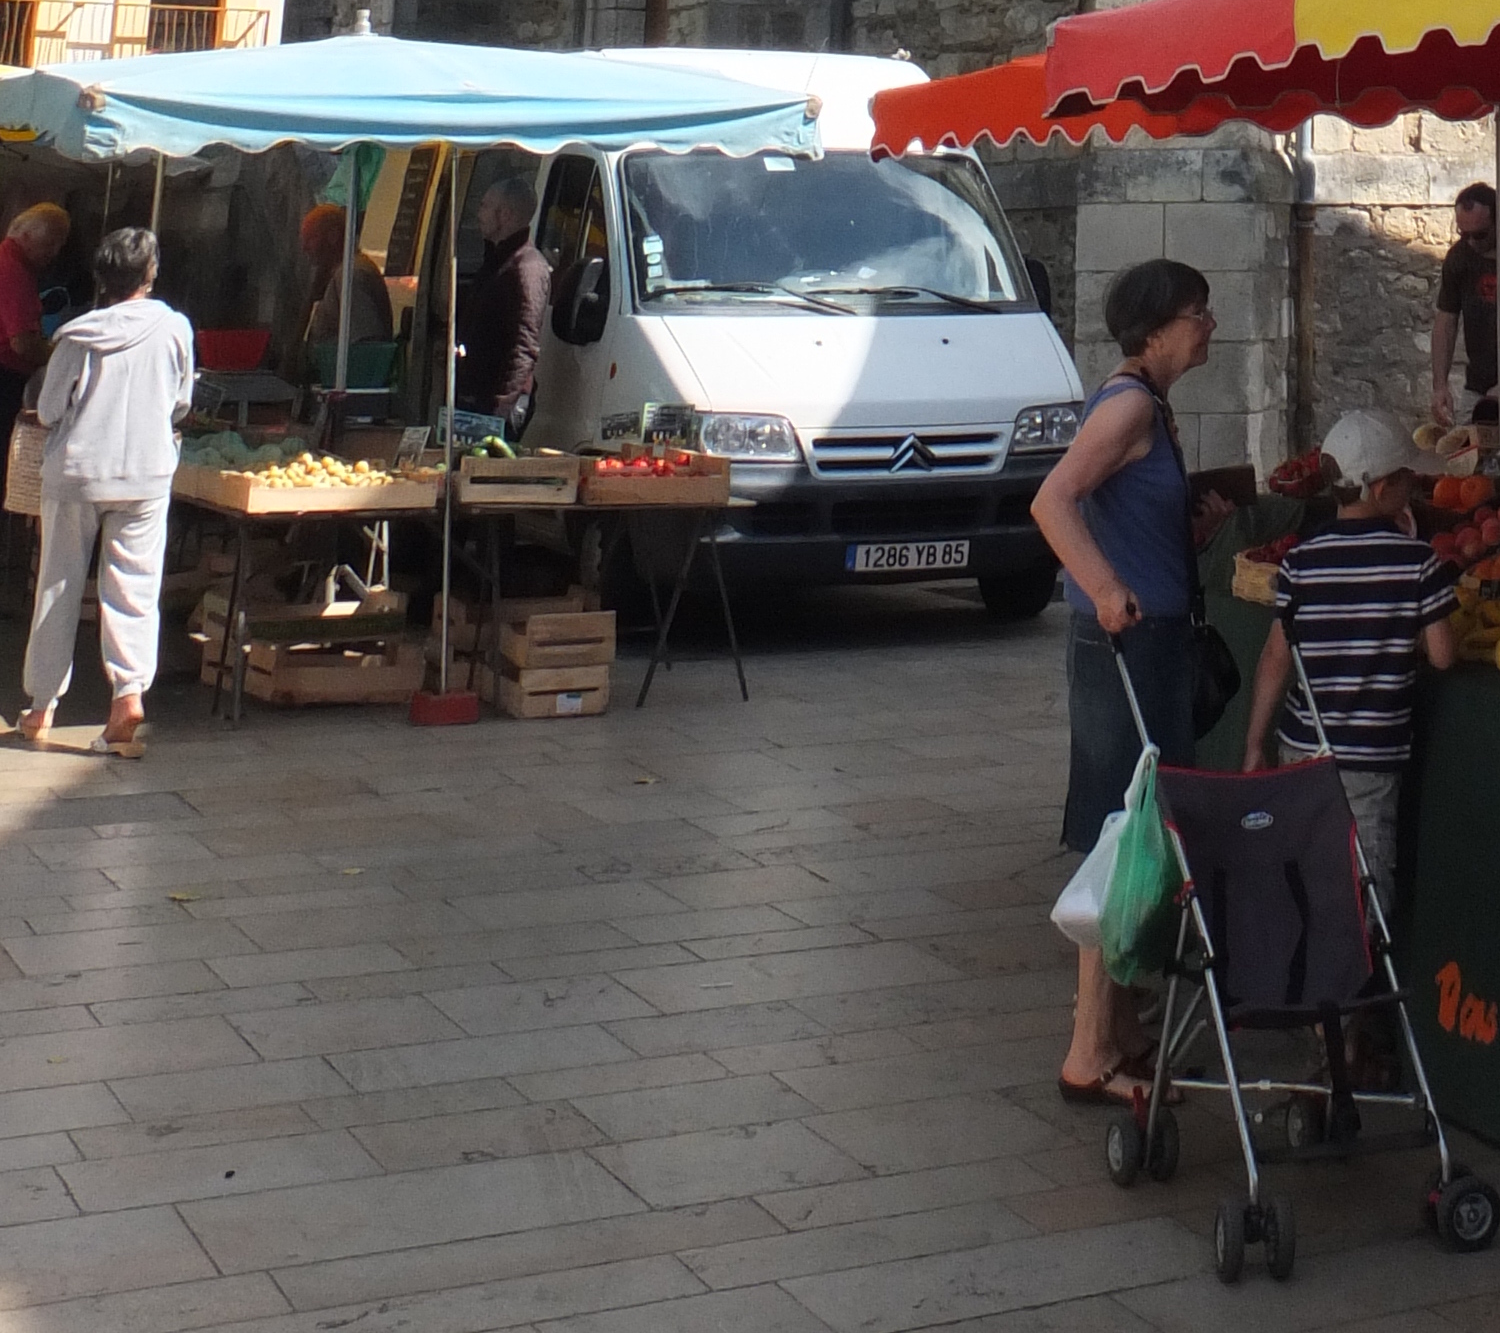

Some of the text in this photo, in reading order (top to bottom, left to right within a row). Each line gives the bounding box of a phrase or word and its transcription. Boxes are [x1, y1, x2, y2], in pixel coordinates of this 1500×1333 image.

[864, 544, 965, 568] 1286 YB 85
